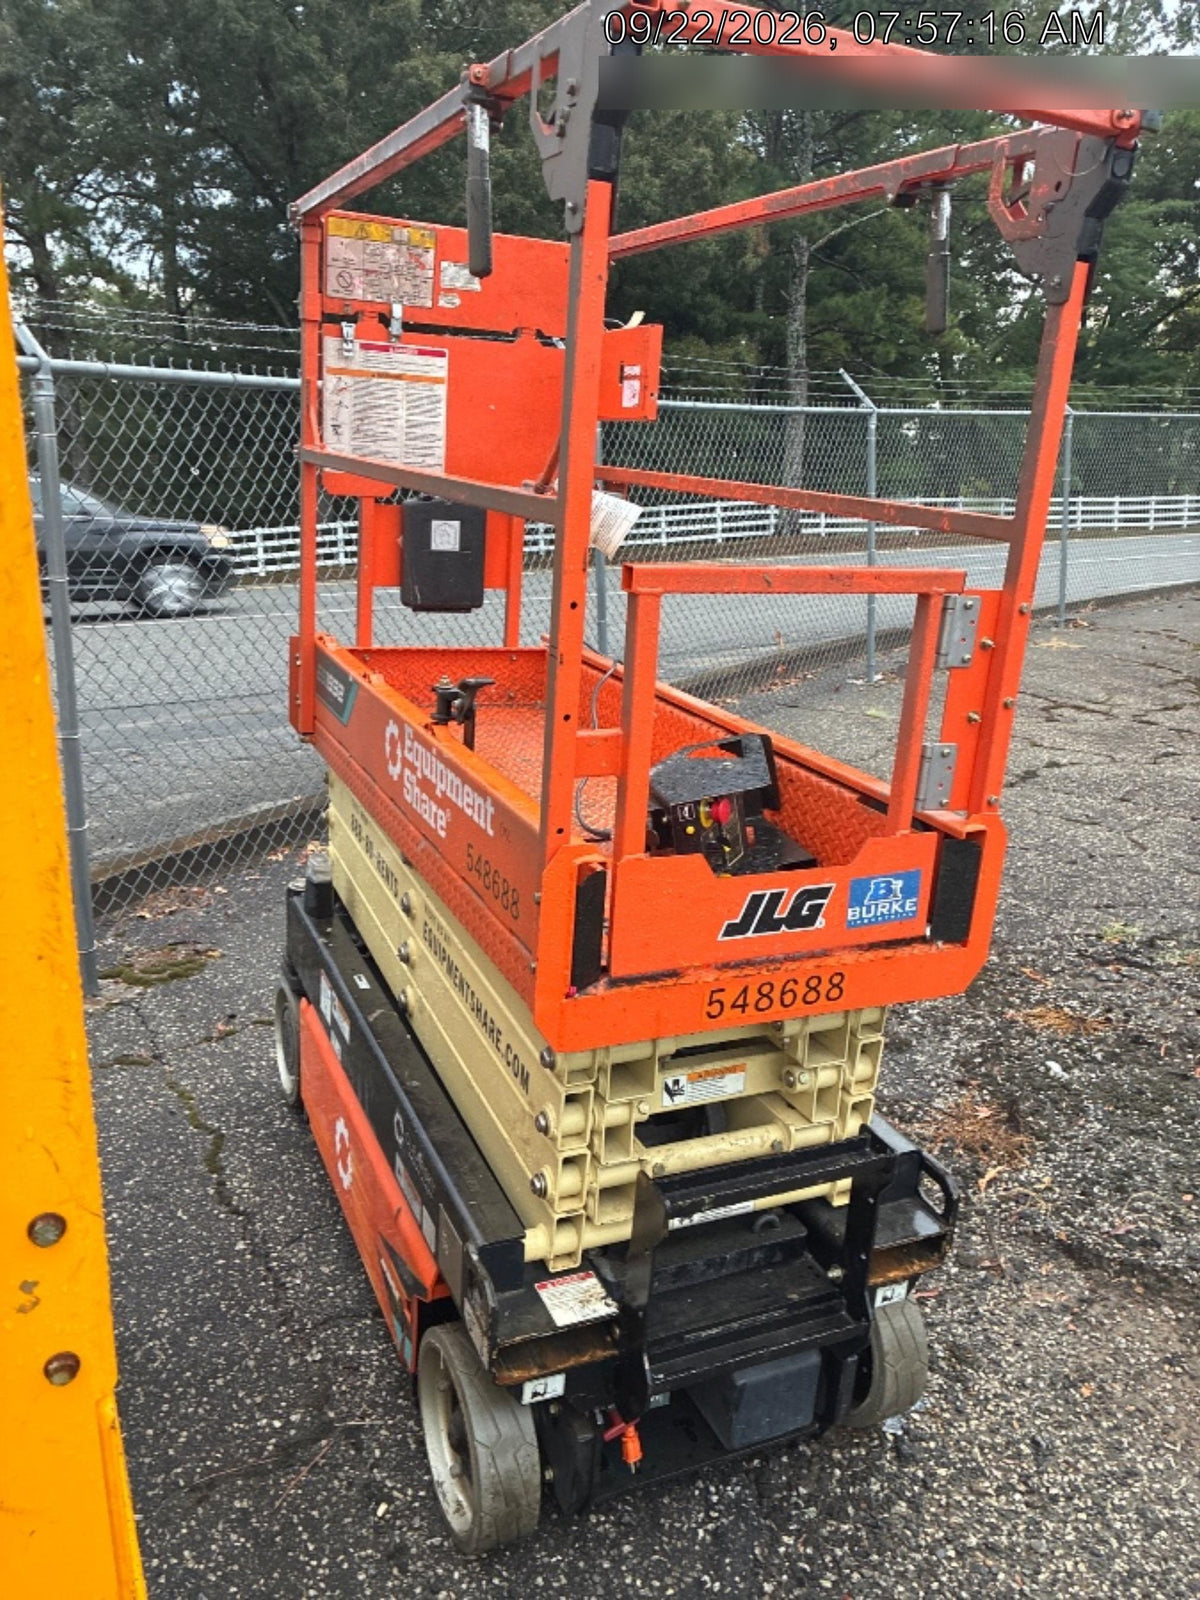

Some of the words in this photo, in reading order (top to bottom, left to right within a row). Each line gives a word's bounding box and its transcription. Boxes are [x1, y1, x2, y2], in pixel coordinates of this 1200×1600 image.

[404, 723, 495, 837] Equipment
[466, 843, 520, 920] 548688
[718, 884, 836, 940] JLG
[847, 897, 918, 921] BURKE
[422, 920, 531, 1096] EQUIPMENTSHARE.COM
[705, 971, 846, 1020] 548688
